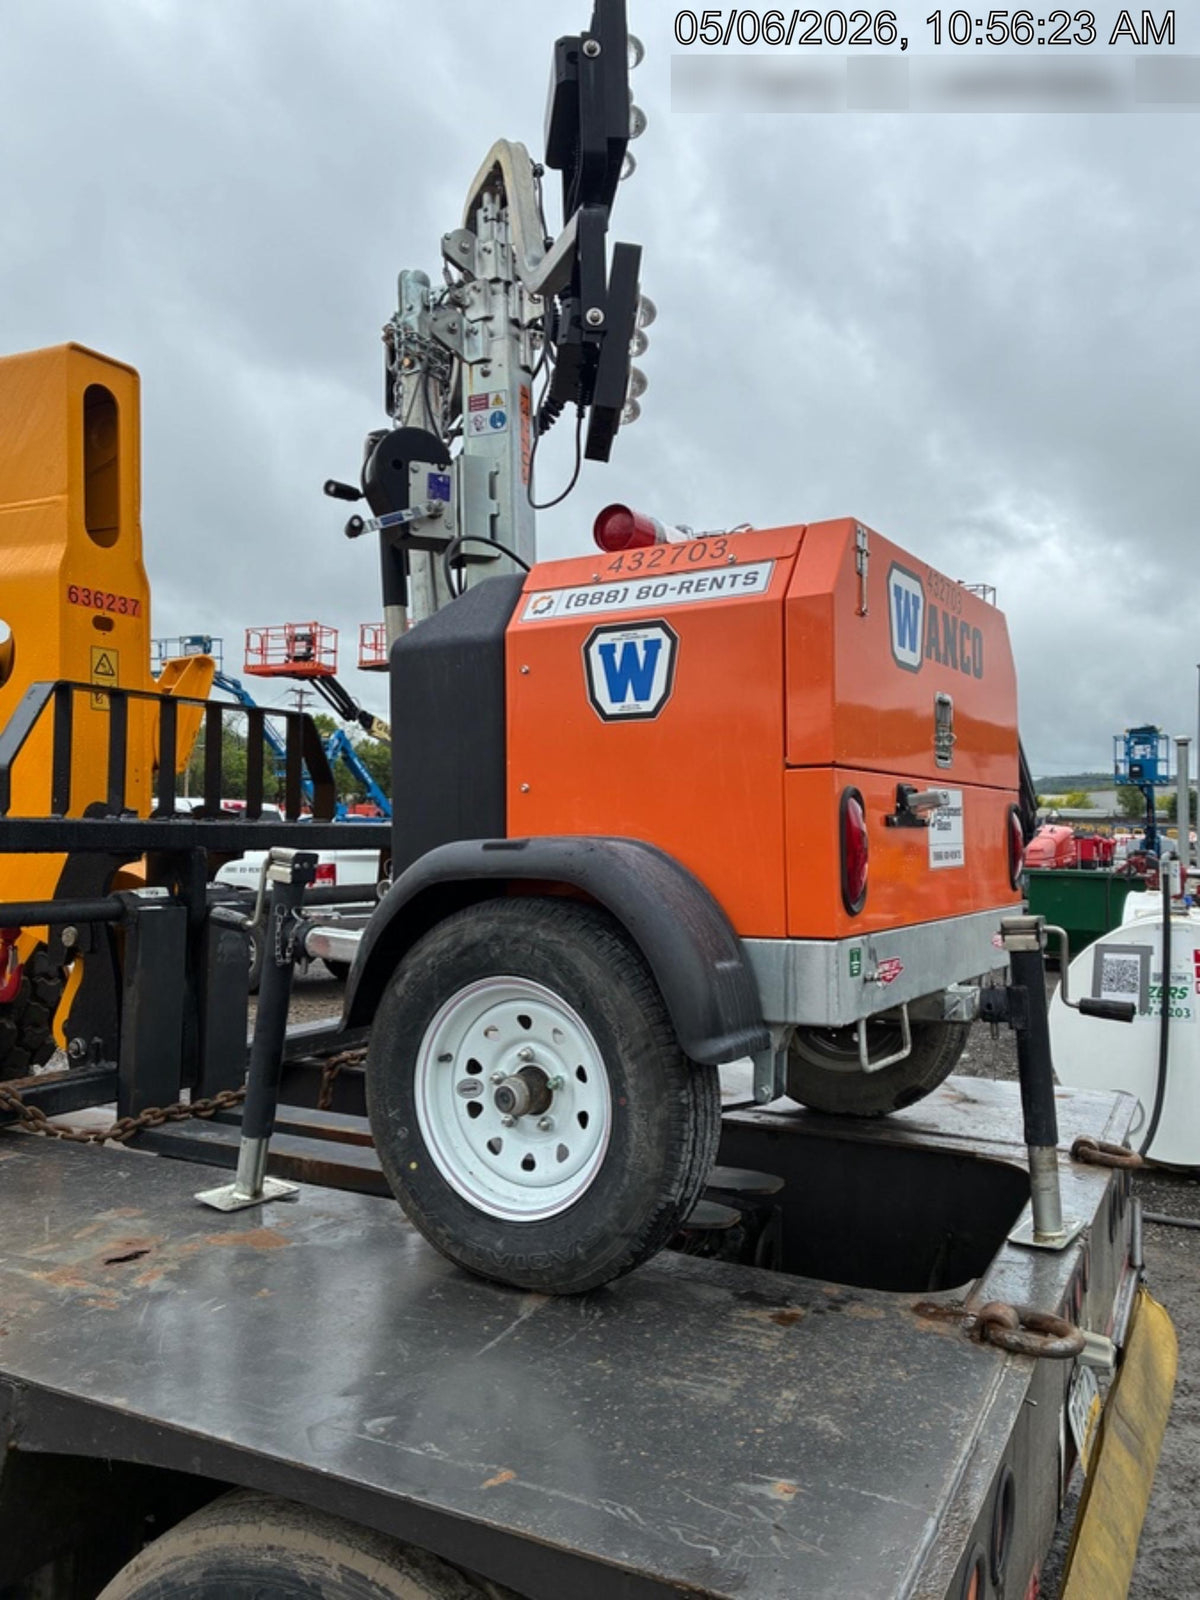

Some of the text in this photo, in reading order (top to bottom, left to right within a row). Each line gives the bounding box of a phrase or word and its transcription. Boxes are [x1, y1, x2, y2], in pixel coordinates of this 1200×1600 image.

[607, 538, 728, 574] 432703
[68, 584, 140, 617] 636237
[564, 570, 760, 610] (888) 80-RENTS
[598, 637, 662, 703] W
